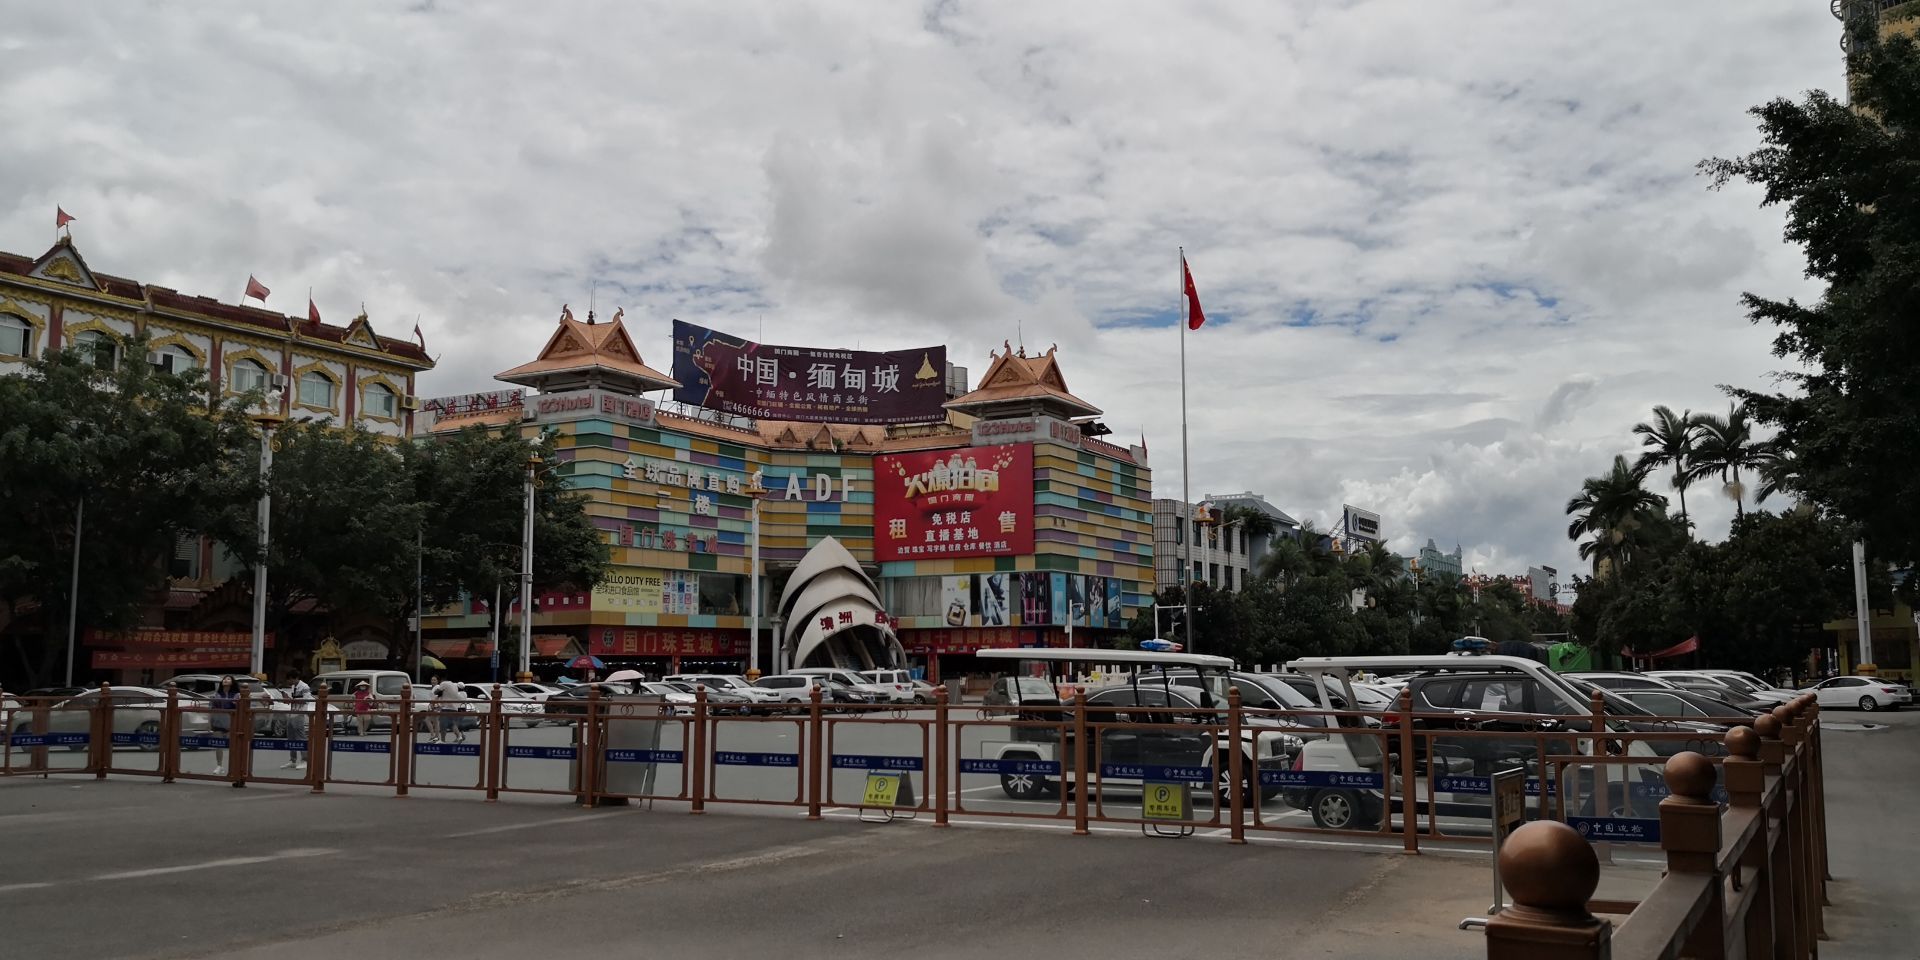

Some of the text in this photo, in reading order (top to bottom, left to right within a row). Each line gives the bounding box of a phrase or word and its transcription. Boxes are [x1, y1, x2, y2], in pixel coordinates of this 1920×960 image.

[738, 353, 900, 393] 中国·缅甸城
[601, 394, 651, 421] 国门酒店
[732, 402, 770, 418] 4666666
[623, 455, 740, 495] 全球品牌直购
[785, 472, 857, 502] ADF
[656, 490, 711, 515] 二楼
[888, 517, 908, 539] 租
[932, 510, 972, 525] 免税店
[998, 510, 1017, 534] 售
[925, 527, 979, 543] 直播基地
[625, 576, 644, 586] DUTY
[645, 578, 661, 588] FREE
[623, 630, 714, 653] 国门珠宝城
